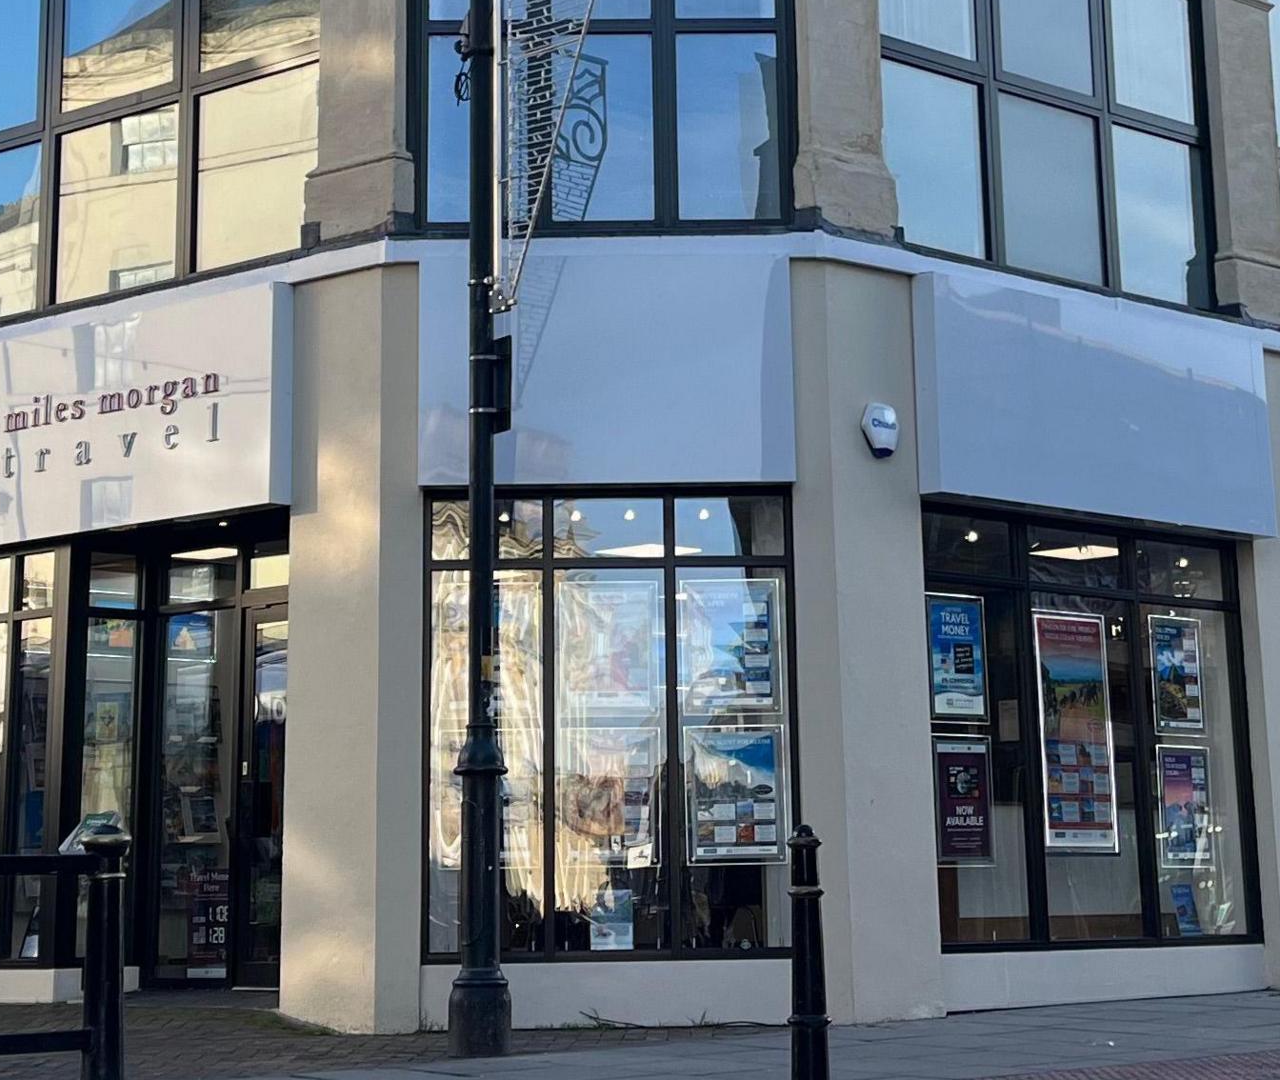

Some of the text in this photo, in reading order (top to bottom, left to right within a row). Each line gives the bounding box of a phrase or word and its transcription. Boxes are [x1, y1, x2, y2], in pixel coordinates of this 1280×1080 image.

[3, 372, 220, 433] miles morgan
[940, 612, 970, 625] TRAVEL
[941, 625, 970, 636] MONEY
[955, 806, 974, 815] NOW
[945, 816, 984, 826] AVAILABLE
